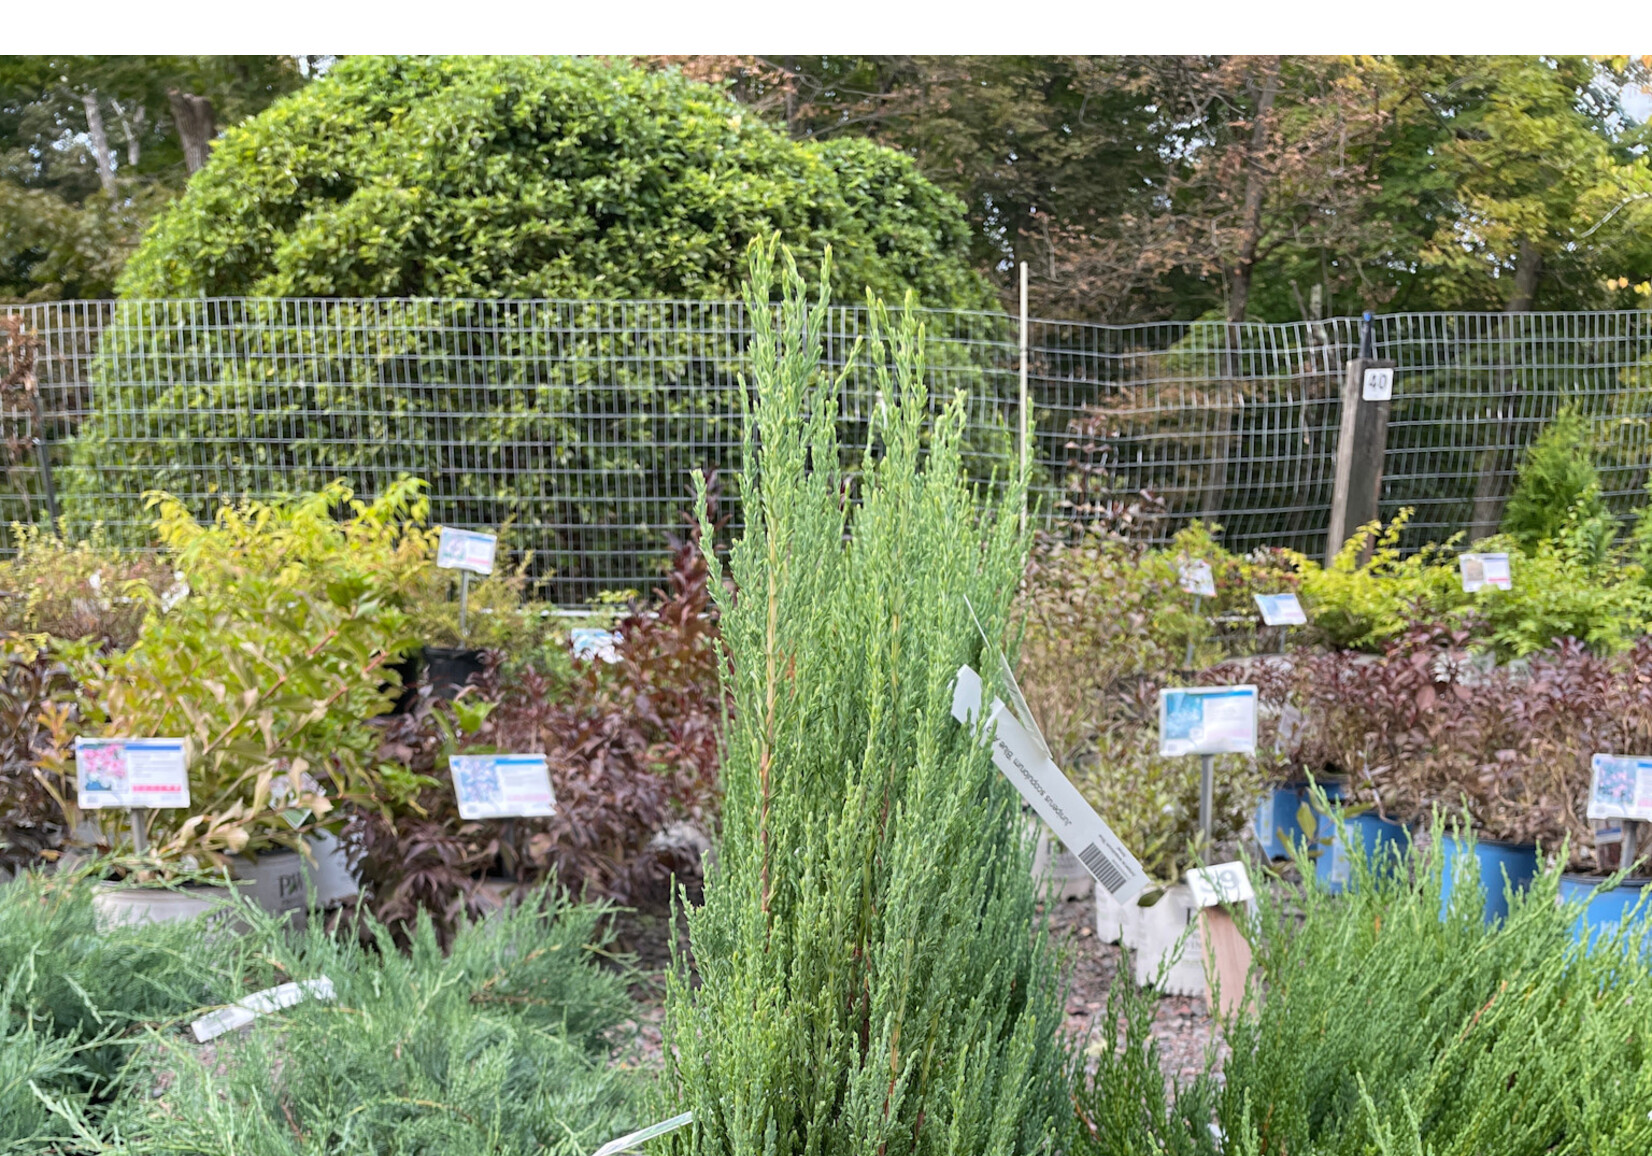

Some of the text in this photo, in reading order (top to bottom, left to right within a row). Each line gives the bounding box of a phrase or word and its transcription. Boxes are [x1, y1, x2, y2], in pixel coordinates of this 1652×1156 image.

[1369, 374, 1386, 390] 40
[1012, 757, 1047, 796] scopulorum
[1044, 794, 1073, 827] Juniperus
